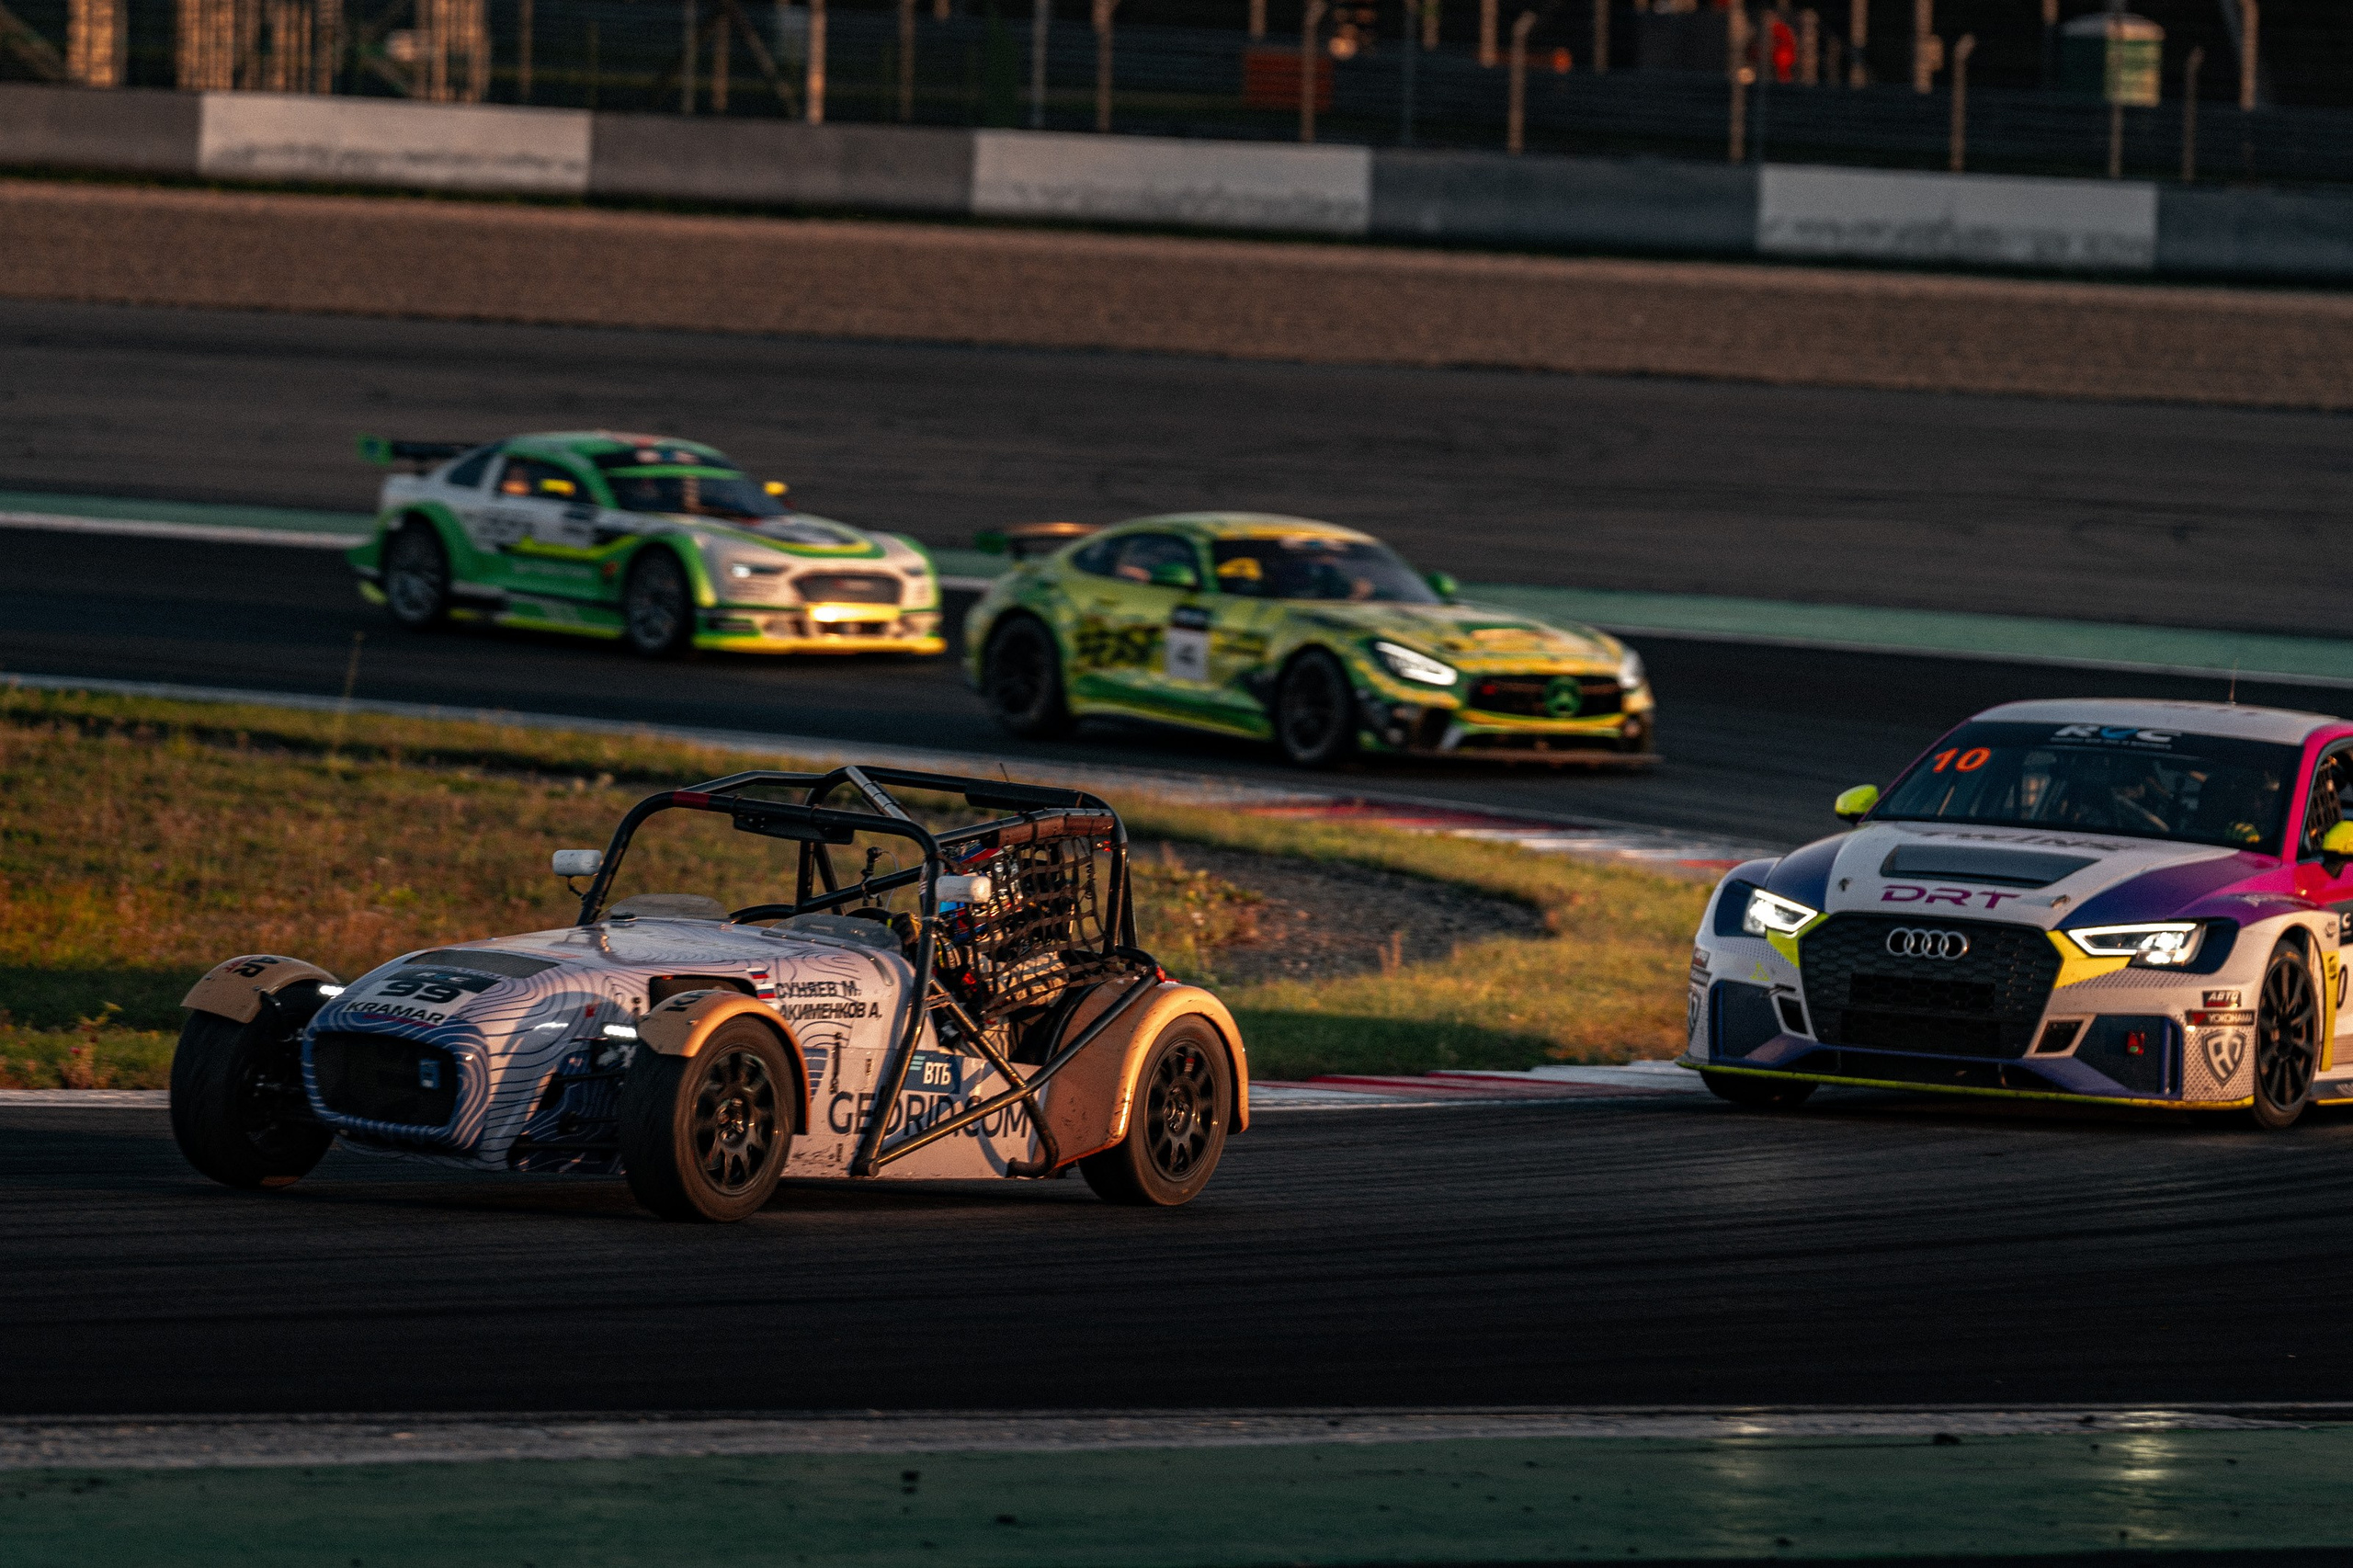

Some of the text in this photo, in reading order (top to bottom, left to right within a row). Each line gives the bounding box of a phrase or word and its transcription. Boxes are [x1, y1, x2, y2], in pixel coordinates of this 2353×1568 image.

[1933, 746, 1992, 773] 10
[1881, 885, 2021, 909] DRT
[376, 981, 461, 1004] 99
[347, 1001, 447, 1024] KRAMAR
[923, 1062, 952, 1085] ВТБ
